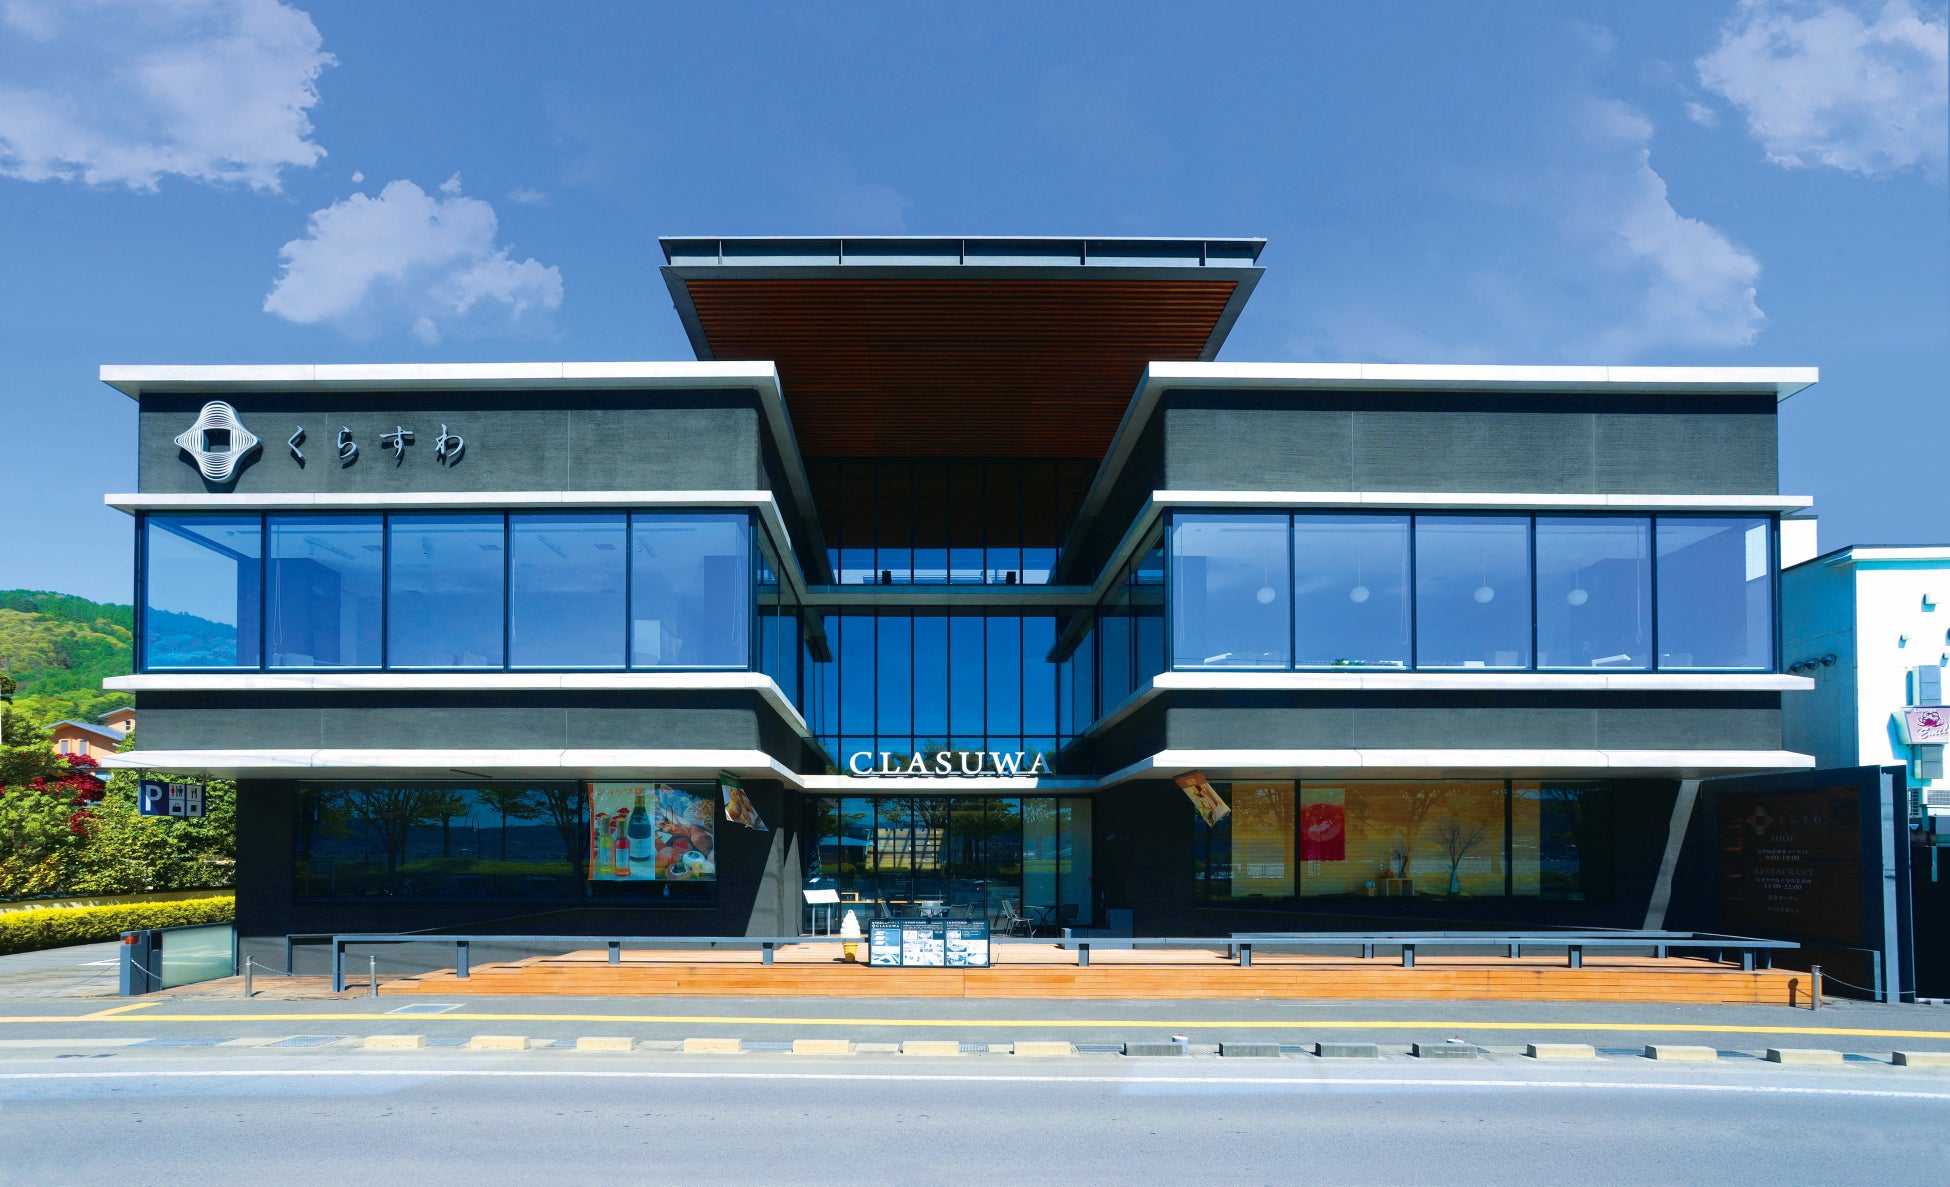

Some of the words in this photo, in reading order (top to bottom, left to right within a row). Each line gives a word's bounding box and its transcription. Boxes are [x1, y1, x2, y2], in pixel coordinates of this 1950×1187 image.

[288, 424, 464, 458] くらすわ
[849, 751, 1053, 775] CLASUWA
[145, 784, 163, 811] P
